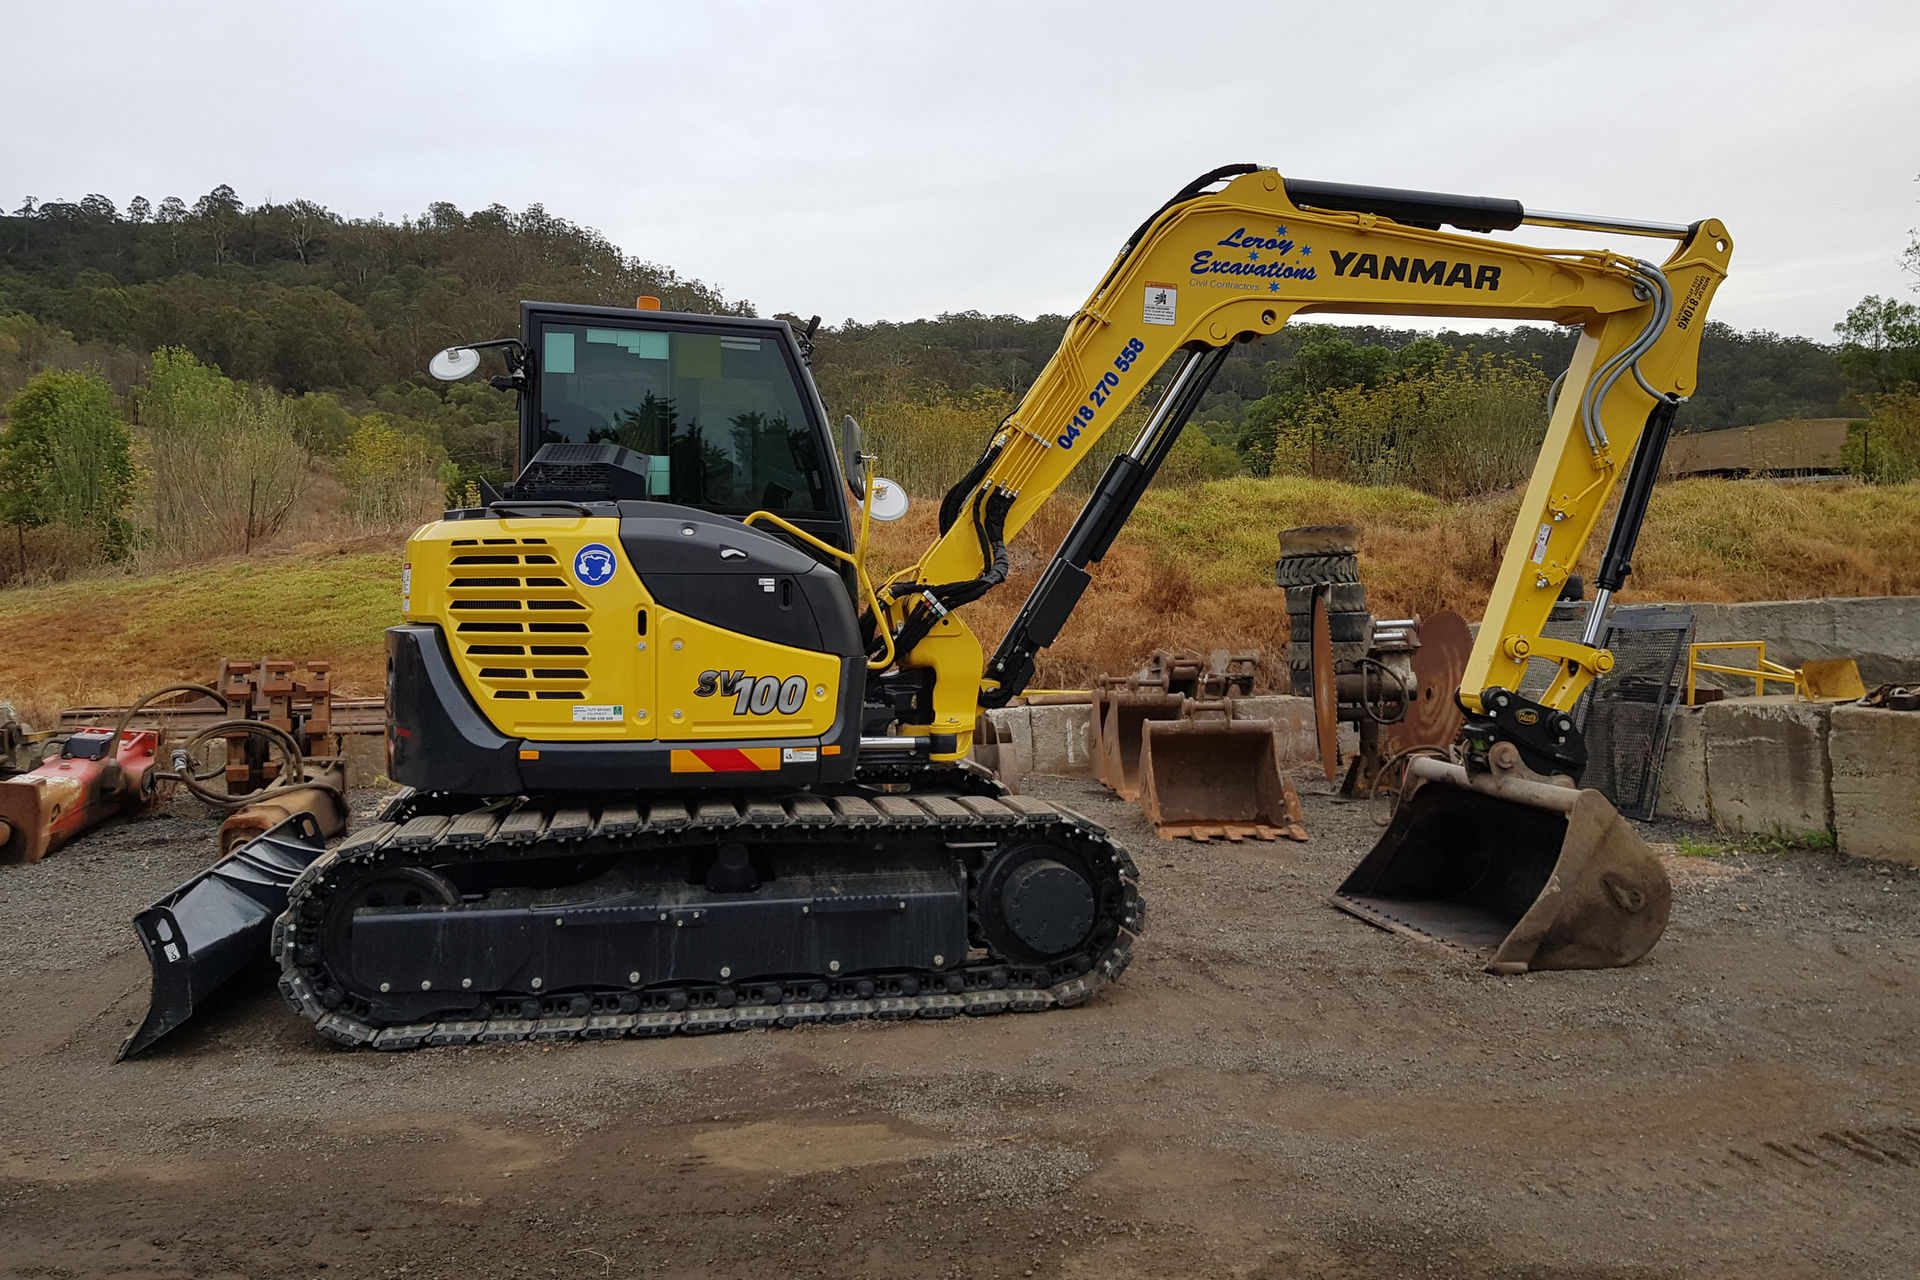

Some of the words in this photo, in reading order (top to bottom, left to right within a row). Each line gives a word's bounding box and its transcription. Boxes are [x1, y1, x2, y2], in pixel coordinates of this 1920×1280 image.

[1217, 227, 1295, 256] Leroy
[1190, 250, 1317, 281] Excavations
[1329, 250, 1502, 291] YANMAR
[1189, 278, 1208, 288] Civil
[1209, 279, 1260, 291] Contractors
[1677, 297, 1699, 330] 810KG
[1057, 405, 1095, 450] 0418
[1089, 371, 1119, 408] 270
[1113, 337, 1145, 373] 558
